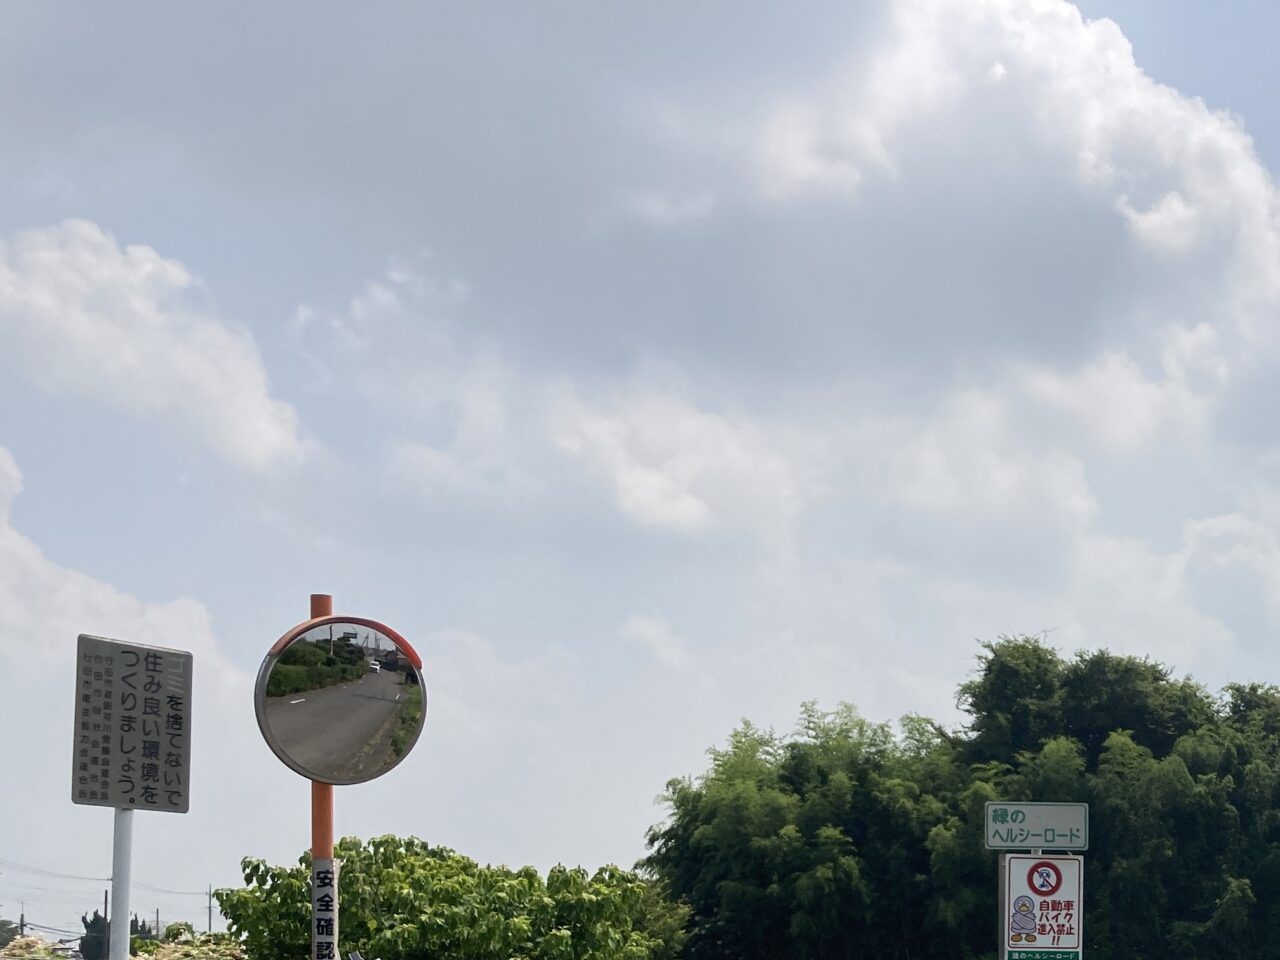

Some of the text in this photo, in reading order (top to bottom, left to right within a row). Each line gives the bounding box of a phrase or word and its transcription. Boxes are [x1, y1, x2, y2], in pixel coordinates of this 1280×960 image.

[140, 651, 164, 804] 住み良い環境を
[992, 808, 1026, 824] 緑の
[992, 827, 1081, 843] ヘルシーロード
[1039, 900, 1075, 912] 自動車
[316, 869, 335, 960] 安全確認
[1039, 912, 1073, 922] バイク
[1037, 924, 1075, 935] 進入禁止
